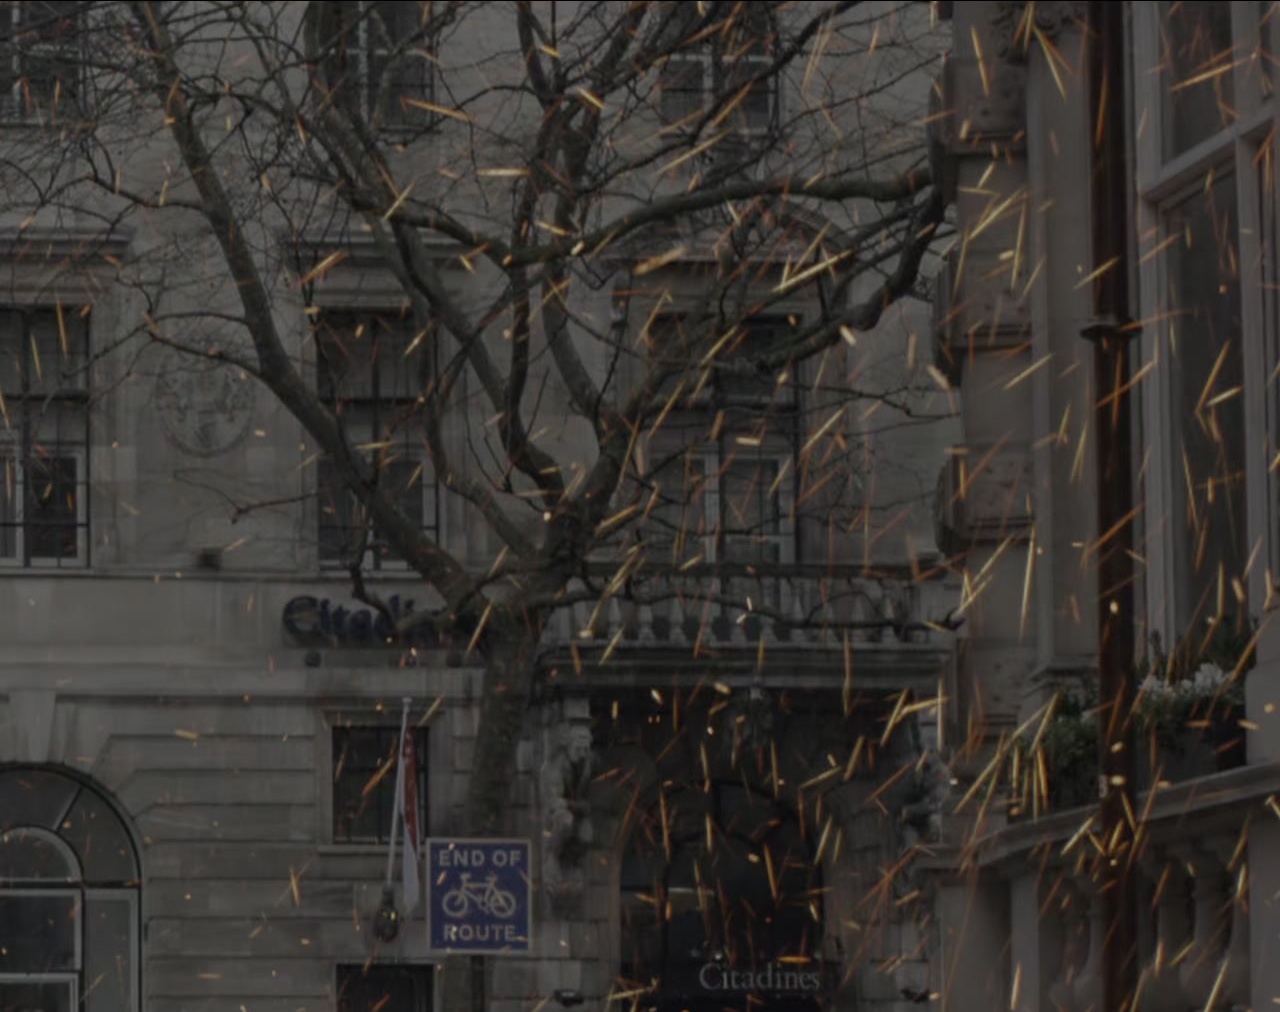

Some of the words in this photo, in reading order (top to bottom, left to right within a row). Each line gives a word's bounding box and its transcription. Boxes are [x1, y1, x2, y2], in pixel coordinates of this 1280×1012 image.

[439, 848, 485, 867] END
[492, 848, 521, 867] OF
[444, 924, 516, 942] ROUTE
[699, 961, 820, 991] Citadines
